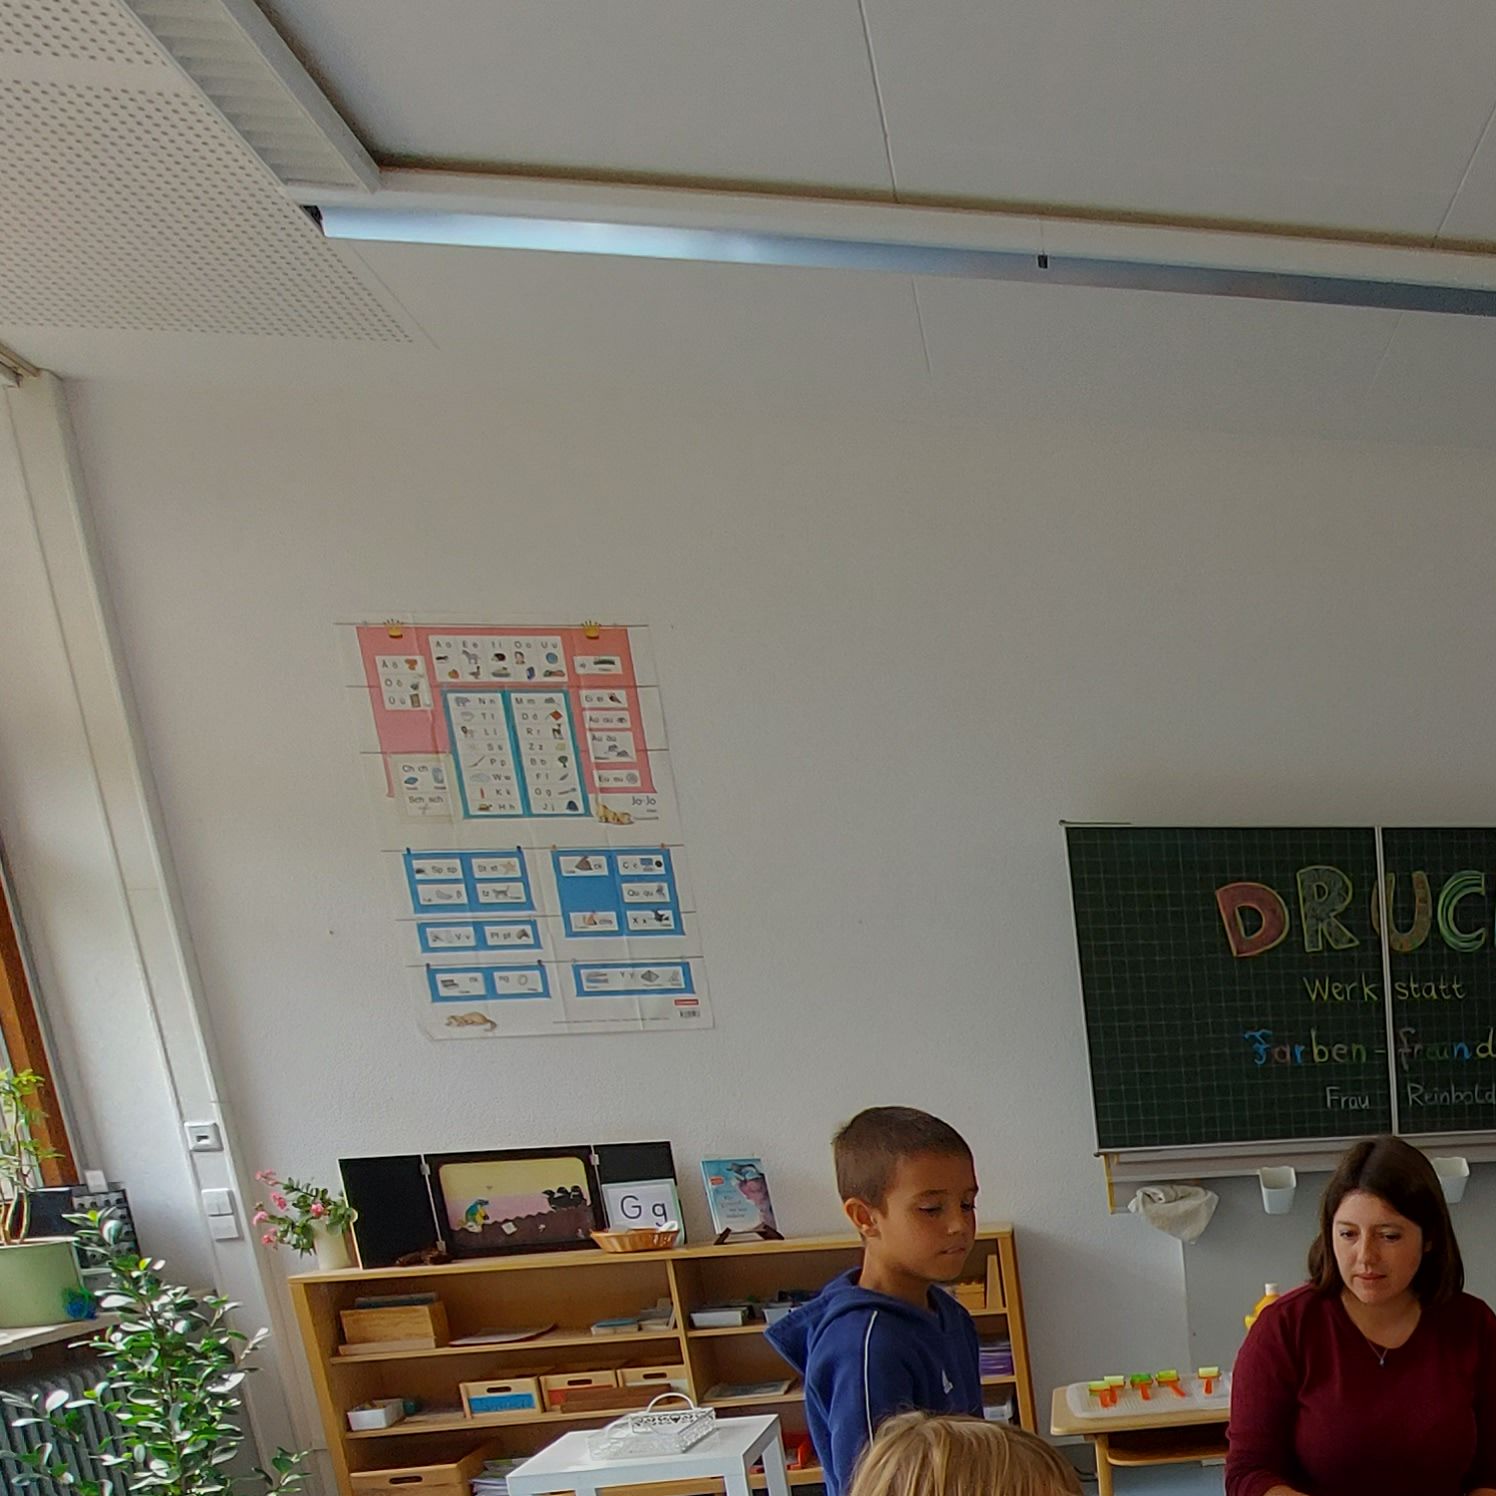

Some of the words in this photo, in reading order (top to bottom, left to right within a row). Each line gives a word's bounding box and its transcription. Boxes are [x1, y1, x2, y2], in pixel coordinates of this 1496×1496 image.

[1325, 1085, 1372, 1111] Frau
[620, 1194, 643, 1220] G
[651, 1201, 668, 1228] g
